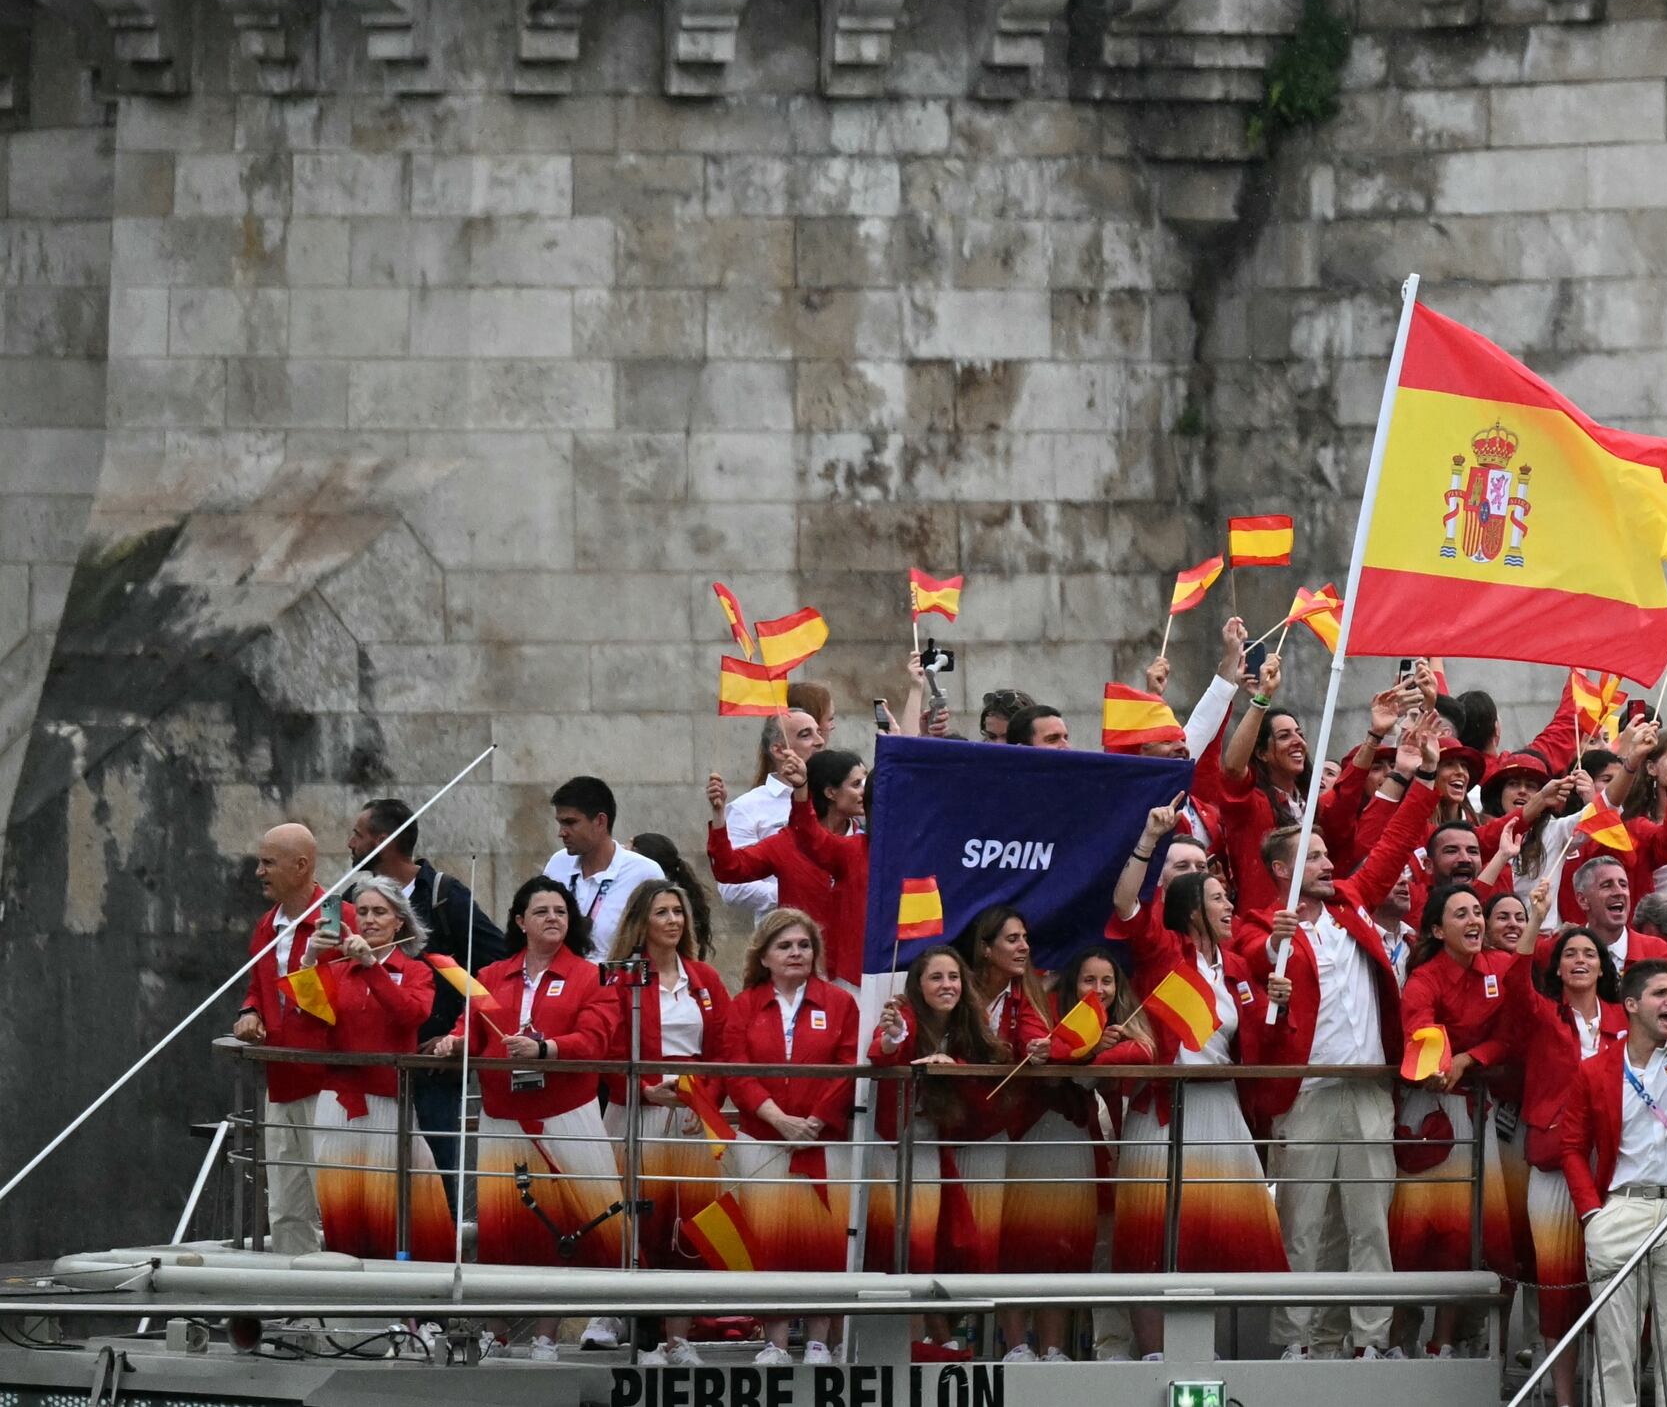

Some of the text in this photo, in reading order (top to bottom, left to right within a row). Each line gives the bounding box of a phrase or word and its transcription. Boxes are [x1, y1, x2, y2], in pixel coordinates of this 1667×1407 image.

[962, 838, 1055, 870] SPAIN
[611, 1364, 1004, 1407] PIERRE BELLON
